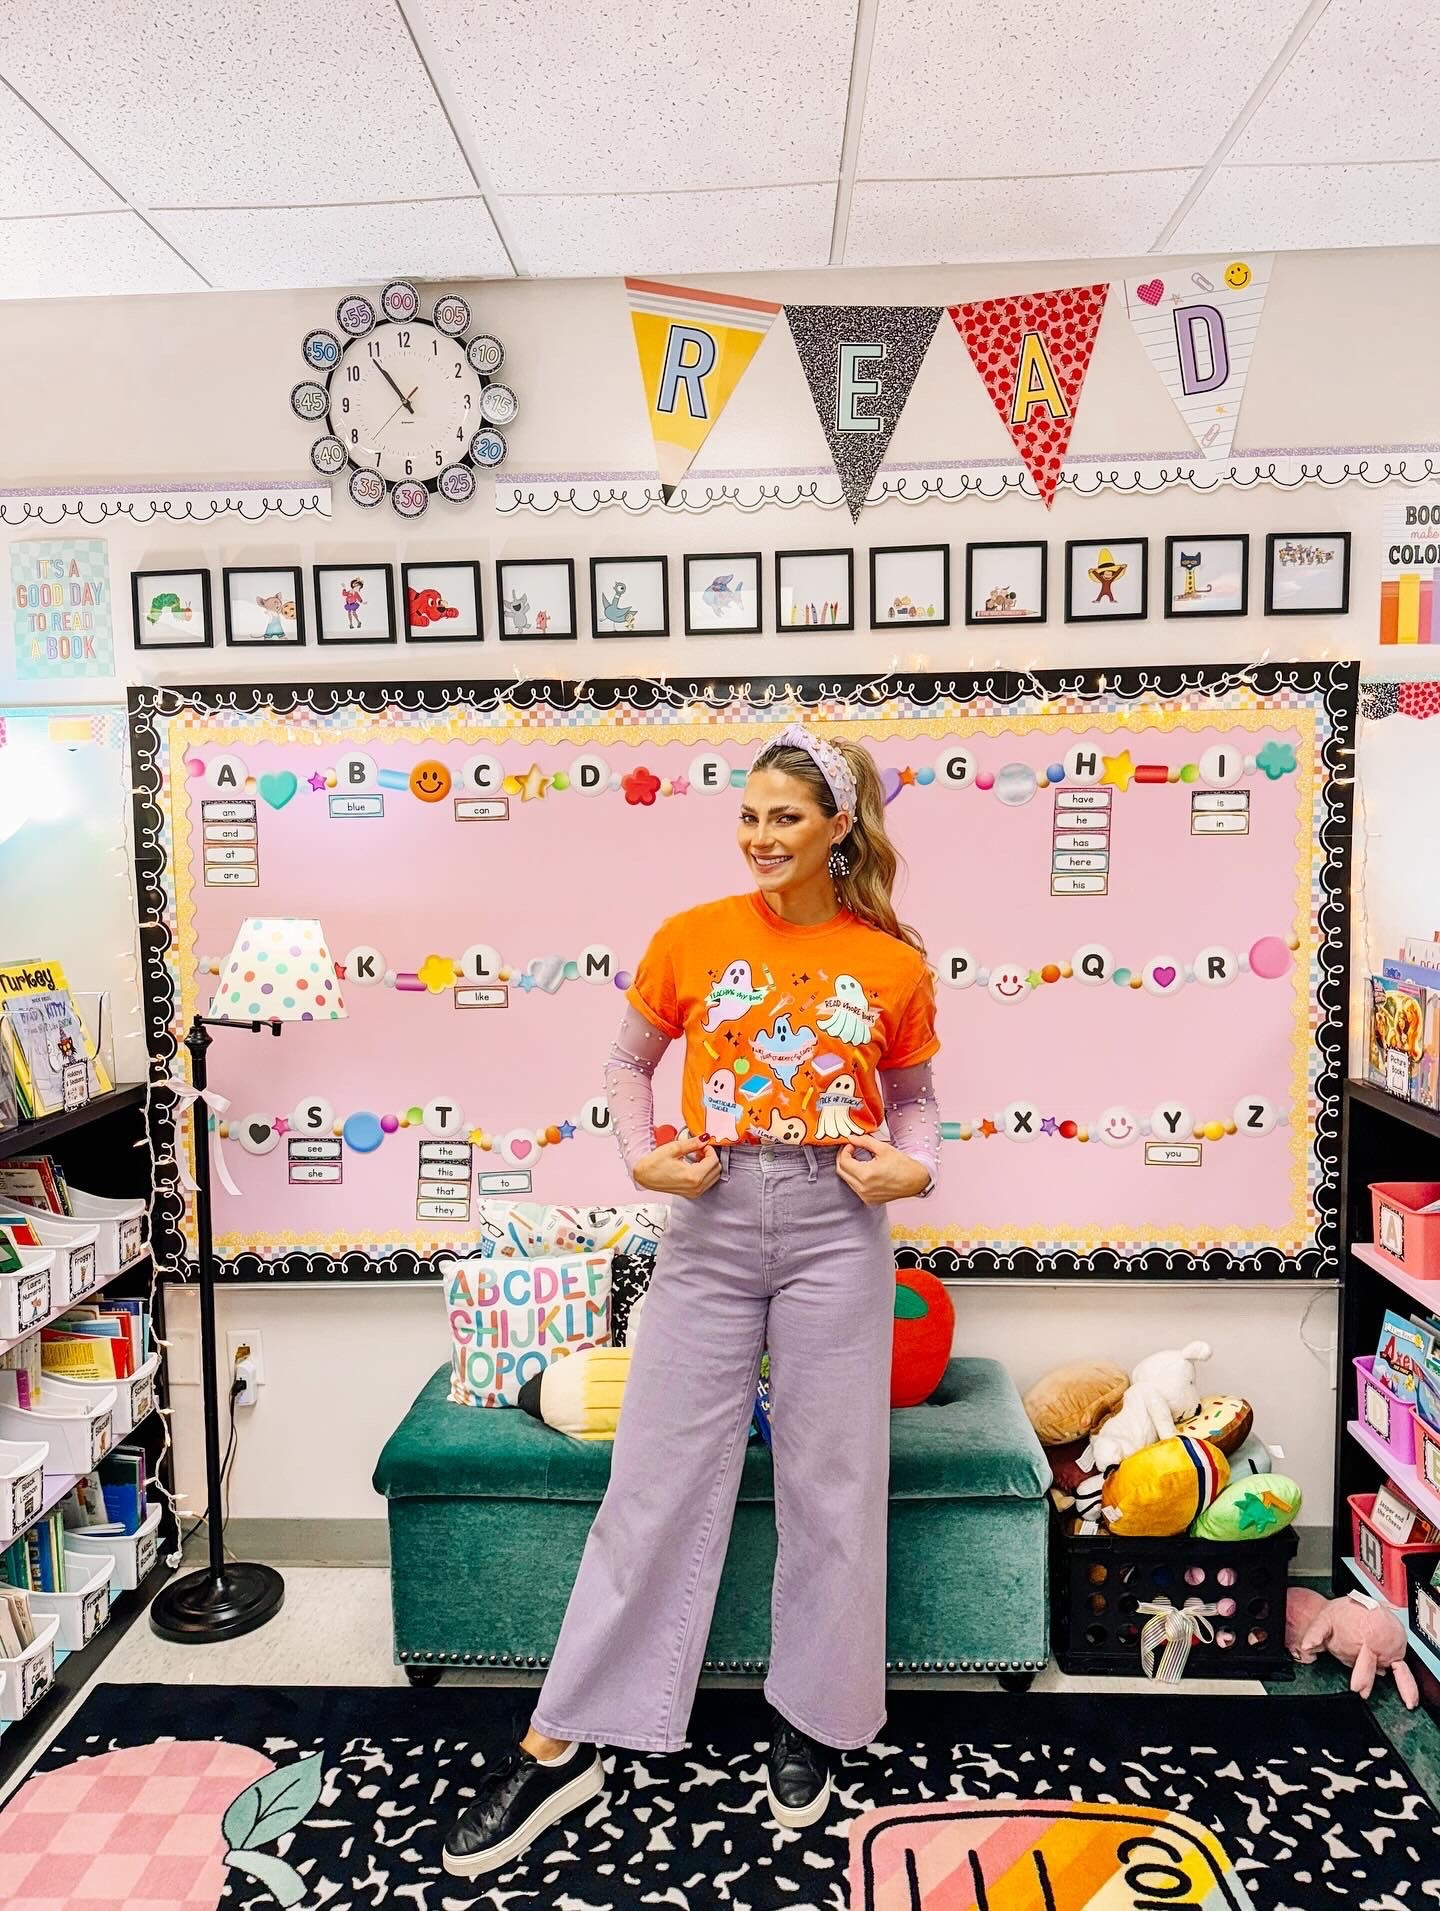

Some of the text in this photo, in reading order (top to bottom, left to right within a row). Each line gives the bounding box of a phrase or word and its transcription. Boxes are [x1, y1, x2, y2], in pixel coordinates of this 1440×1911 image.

[398, 332, 410, 348] 12
[433, 340, 437, 355] 1
[368, 342, 379, 357] 11
[347, 366, 360, 381] 10
[455, 363, 462, 378] 2
[342, 398, 349, 412] 9
[464, 395, 471, 409] 3
[352, 429, 358, 443] 8
[456, 427, 463, 441] 4
[375, 453, 382, 467] 7
[435, 451, 442, 465] 5
[405, 460, 412, 474] 6
[1410, 527, 1439, 540] make
[1389, 544, 1440, 565] COLO
[36, 559, 80, 579] IT'S A
[16, 582, 102, 608] GOOD DAY
[27, 611, 93, 632] TO READ
[31, 635, 97, 660] A BOOK
[946, 757, 966, 780] G
[1076, 752, 1097, 776] H
[1218, 754, 1225, 777] I
[217, 764, 237, 787] A
[349, 761, 365, 784] B
[473, 764, 490, 787] C
[581, 765, 599, 787] D
[703, 763, 718, 786] E
[1071, 794, 1094, 804] have
[1216, 798, 1224, 807] is
[347, 802, 366, 812] blue
[474, 807, 490, 815] can
[1076, 816, 1088, 825] he
[1216, 819, 1224, 828] in
[222, 829, 239, 838] and
[1073, 837, 1089, 847] has
[226, 850, 235, 859] at
[1069, 857, 1091, 866] here
[1073, 880, 1086, 889] his
[357, 956, 375, 977] K
[476, 955, 489, 976] L
[586, 954, 609, 977] M
[951, 957, 968, 979] P
[1082, 954, 1105, 978] Q
[1207, 957, 1226, 979] R
[0, 968, 56, 993] Turkey
[475, 992, 489, 1001] like
[825, 1000, 841, 1008] READ
[44, 1001, 66, 1019] KITTY
[1390, 1054, 1406, 1069] Picture
[1391, 1066, 1405, 1078] Books
[307, 1106, 322, 1128] S
[435, 1106, 453, 1128] T
[591, 1107, 609, 1129] U
[1014, 1111, 1033, 1133] X
[1163, 1111, 1182, 1133] Y
[1247, 1105, 1264, 1128] Z
[307, 1145, 323, 1153] see
[438, 1147, 453, 1156] the
[1165, 1151, 1182, 1159] you
[308, 1169, 323, 1178] she
[438, 1167, 454, 1176] this
[501, 1179, 510, 1188] to
[436, 1187, 455, 1196] that
[435, 1205, 455, 1216] they
[1386, 1214, 1399, 1246] A
[74, 1253, 91, 1266] Froggy
[27, 1278, 42, 1290] Laura
[22, 1285, 46, 1300] Numeroff
[134, 1380, 149, 1397] School
[21, 1477, 36, 1492] Black
[19, 1485, 38, 1504] Lagoon
[1377, 1507, 1401, 1530] the Cheese
[1380, 1500, 1405, 1523] Jasper and
[1365, 1533, 1377, 1568] H
[32, 1660, 44, 1673] Eric
[31, 1666, 47, 1685] Carle
